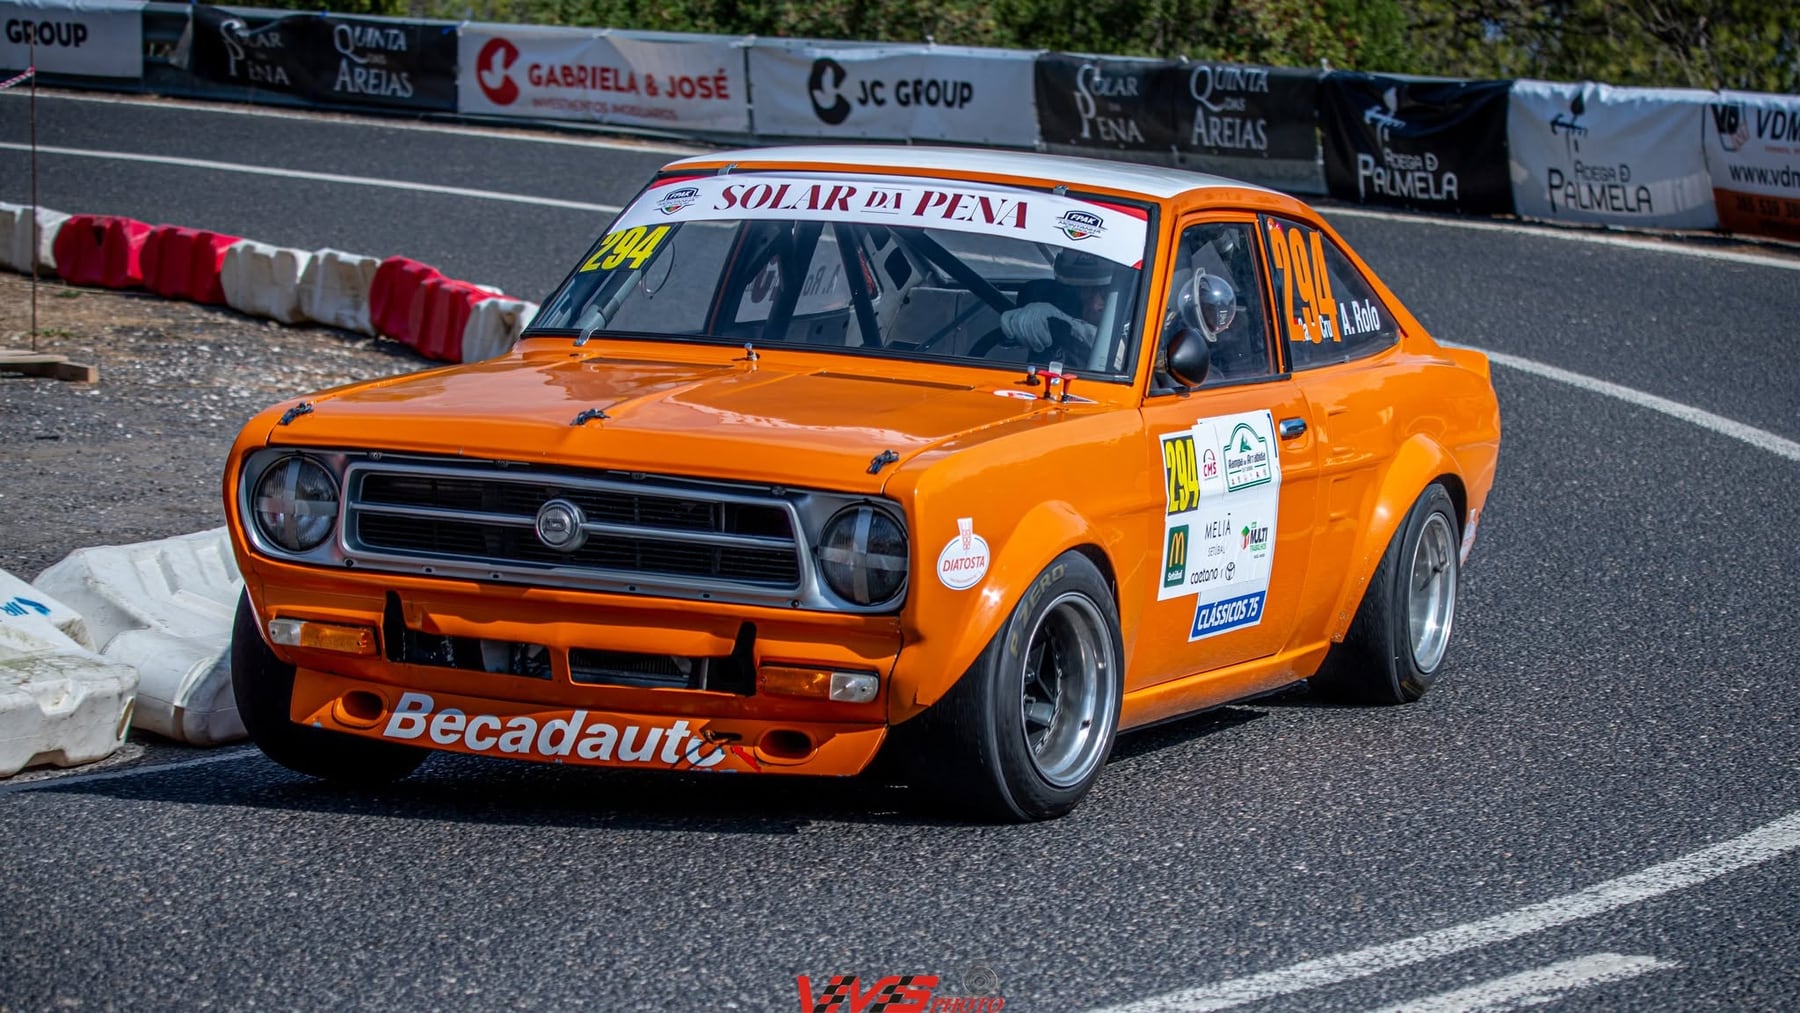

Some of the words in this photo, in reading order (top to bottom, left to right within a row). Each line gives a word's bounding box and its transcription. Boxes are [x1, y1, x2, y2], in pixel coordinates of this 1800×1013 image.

[6, 19, 88, 48] GROUP
[333, 24, 408, 64] QUINTA
[333, 58, 414, 98] AREIAS
[528, 63, 640, 96] GABRIELA
[644, 73, 659, 97] &
[665, 68, 731, 100] JOSÉ
[856, 78, 886, 107] JC
[894, 78, 974, 111] GROUP
[1190, 65, 1270, 113] QUINTA
[1191, 105, 1269, 150] AREIAS
[1357, 153, 1459, 201] PALMELA
[1547, 168, 1654, 214] PALMELA
[713, 183, 857, 212] SOLAR
[864, 190, 902, 209] DA
[911, 190, 1029, 230] PENA
[1070, 213, 1096, 225] FPAK
[579, 225, 671, 273] 294
[1268, 227, 1342, 344] 294
[1339, 302, 1355, 336] A.
[1354, 299, 1381, 333] Rolo
[1165, 438, 1199, 513] 294
[1203, 461, 1217, 478] CMS
[1250, 526, 1268, 545] MULTI
[942, 555, 985, 573] DIATOSTA
[1197, 601, 1249, 631] CLÁSSICOS
[1247, 596, 1260, 617] 75
